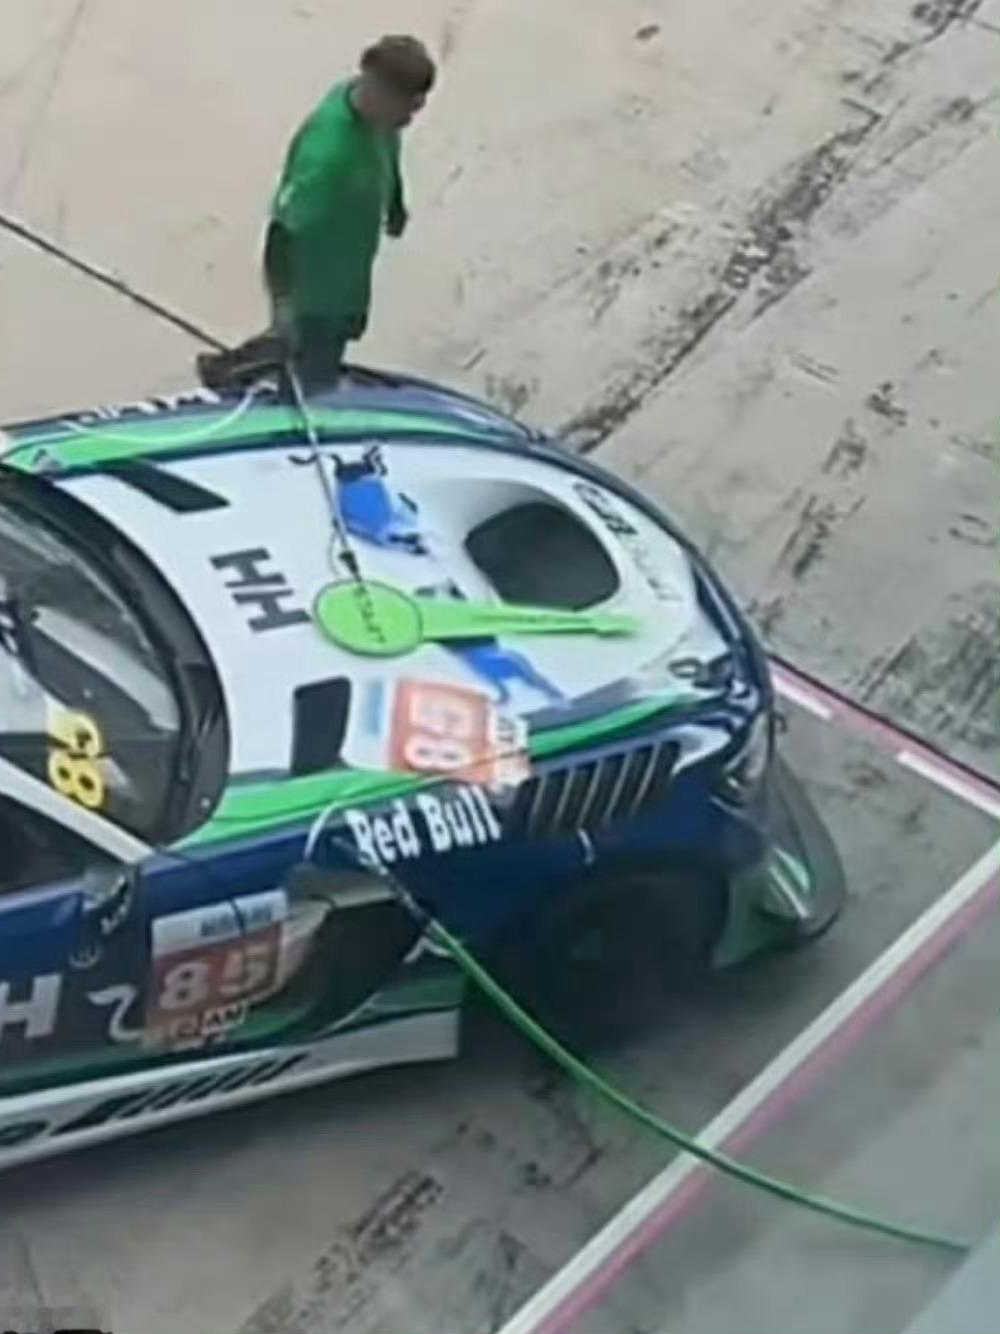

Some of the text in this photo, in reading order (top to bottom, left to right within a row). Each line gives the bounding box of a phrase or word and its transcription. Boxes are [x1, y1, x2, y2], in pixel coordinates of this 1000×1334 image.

[48, 711, 104, 807] 85
[345, 784, 501, 875] Red Bull
